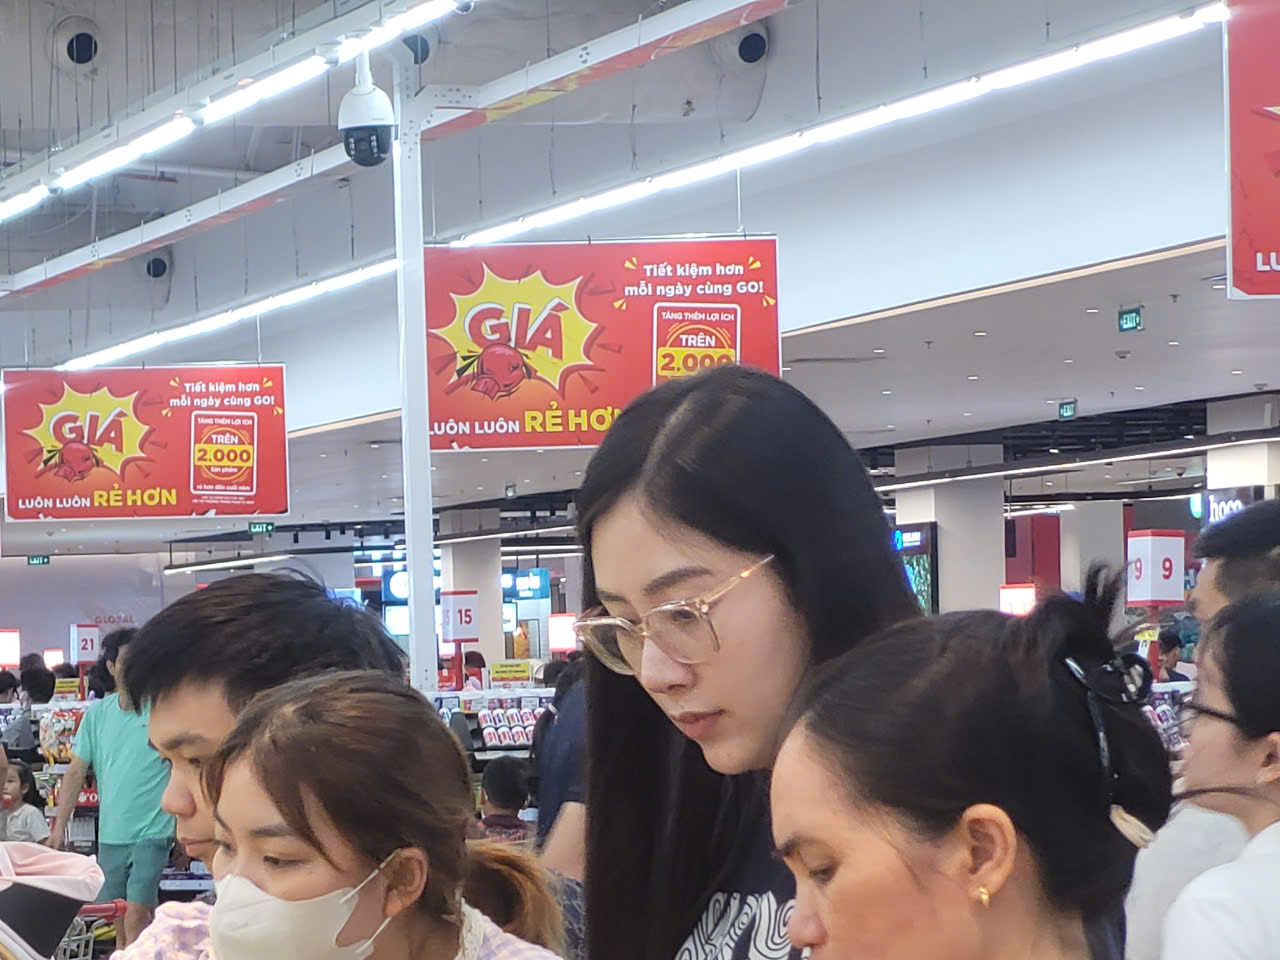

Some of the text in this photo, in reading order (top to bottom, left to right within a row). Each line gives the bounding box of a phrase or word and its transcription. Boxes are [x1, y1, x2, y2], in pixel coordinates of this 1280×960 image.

[642, 262, 744, 279] Tiết kiệm hơn
[624, 281, 764, 297] mỗi ngày cùng GO!
[464, 297, 571, 361] GIÁ
[680, 332, 716, 347] TRÊN
[184, 381, 260, 394] Tiết kiệm hơn
[169, 394, 275, 408] mỗi ngày cùng GO!
[475, 417, 520, 434] LUÔN
[524, 400, 564, 433] RẺ
[50, 408, 128, 453] GIÁ
[211, 432, 239, 444] TRÊN
[197, 449, 251, 463] 2.000
[18, 495, 53, 509] LUÔN
[55, 495, 91, 508] LUÔN
[93, 483, 123, 507] RẺ
[126, 487, 177, 505] HƠN
[1134, 558, 1143, 581] 9
[1161, 557, 1173, 580] 9
[457, 608, 473, 625] 15
[81, 638, 94, 651] 21
